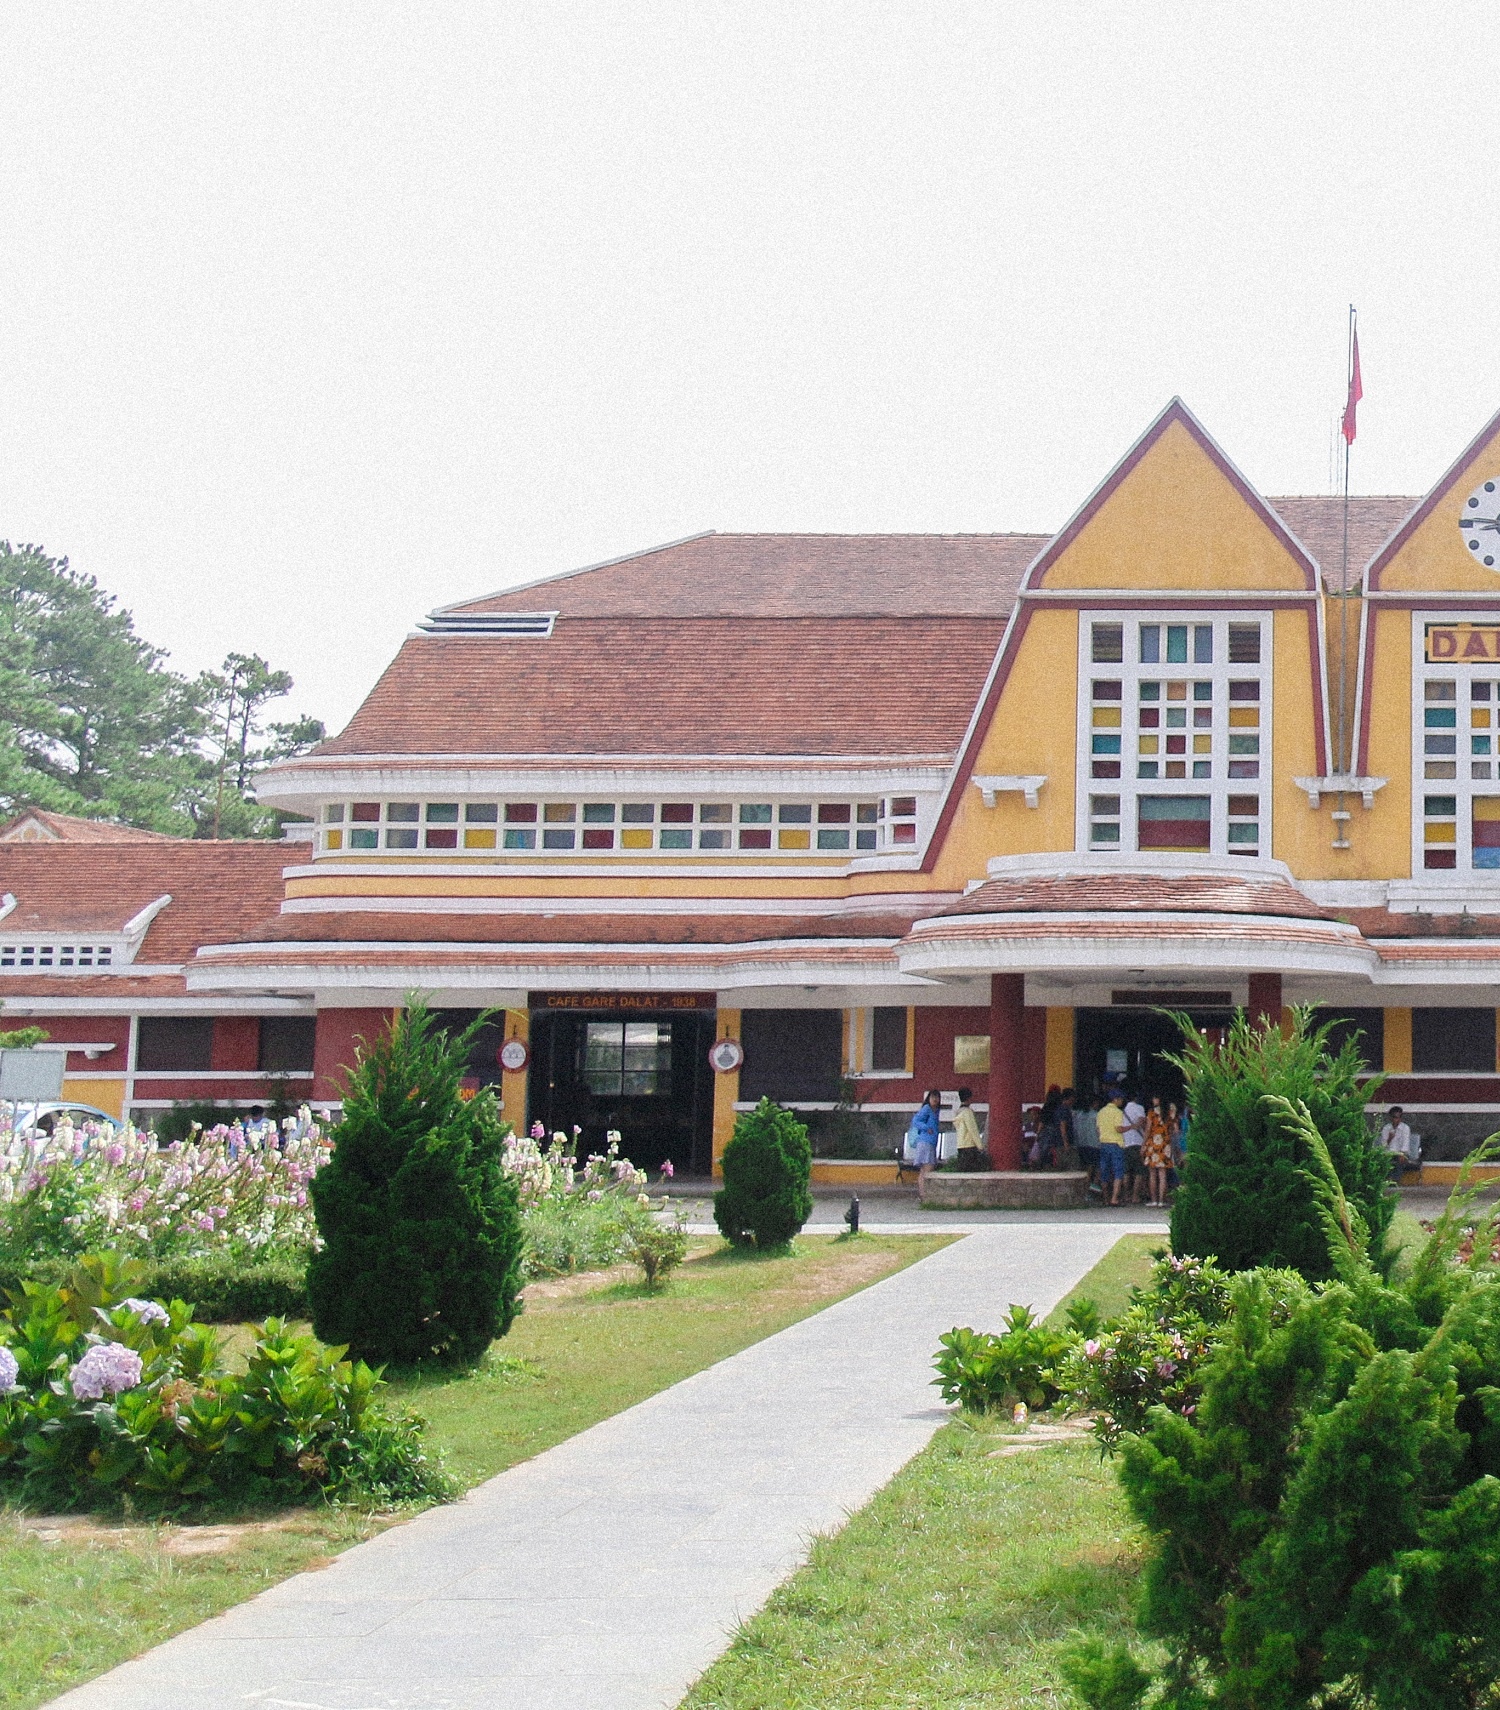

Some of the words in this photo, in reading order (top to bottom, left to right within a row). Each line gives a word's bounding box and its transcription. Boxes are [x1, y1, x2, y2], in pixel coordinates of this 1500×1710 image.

[547, 996, 579, 1007] CAFE
[583, 996, 616, 1007] GARE
[619, 996, 659, 1007] DALAT
[672, 996, 696, 1007] 1938
